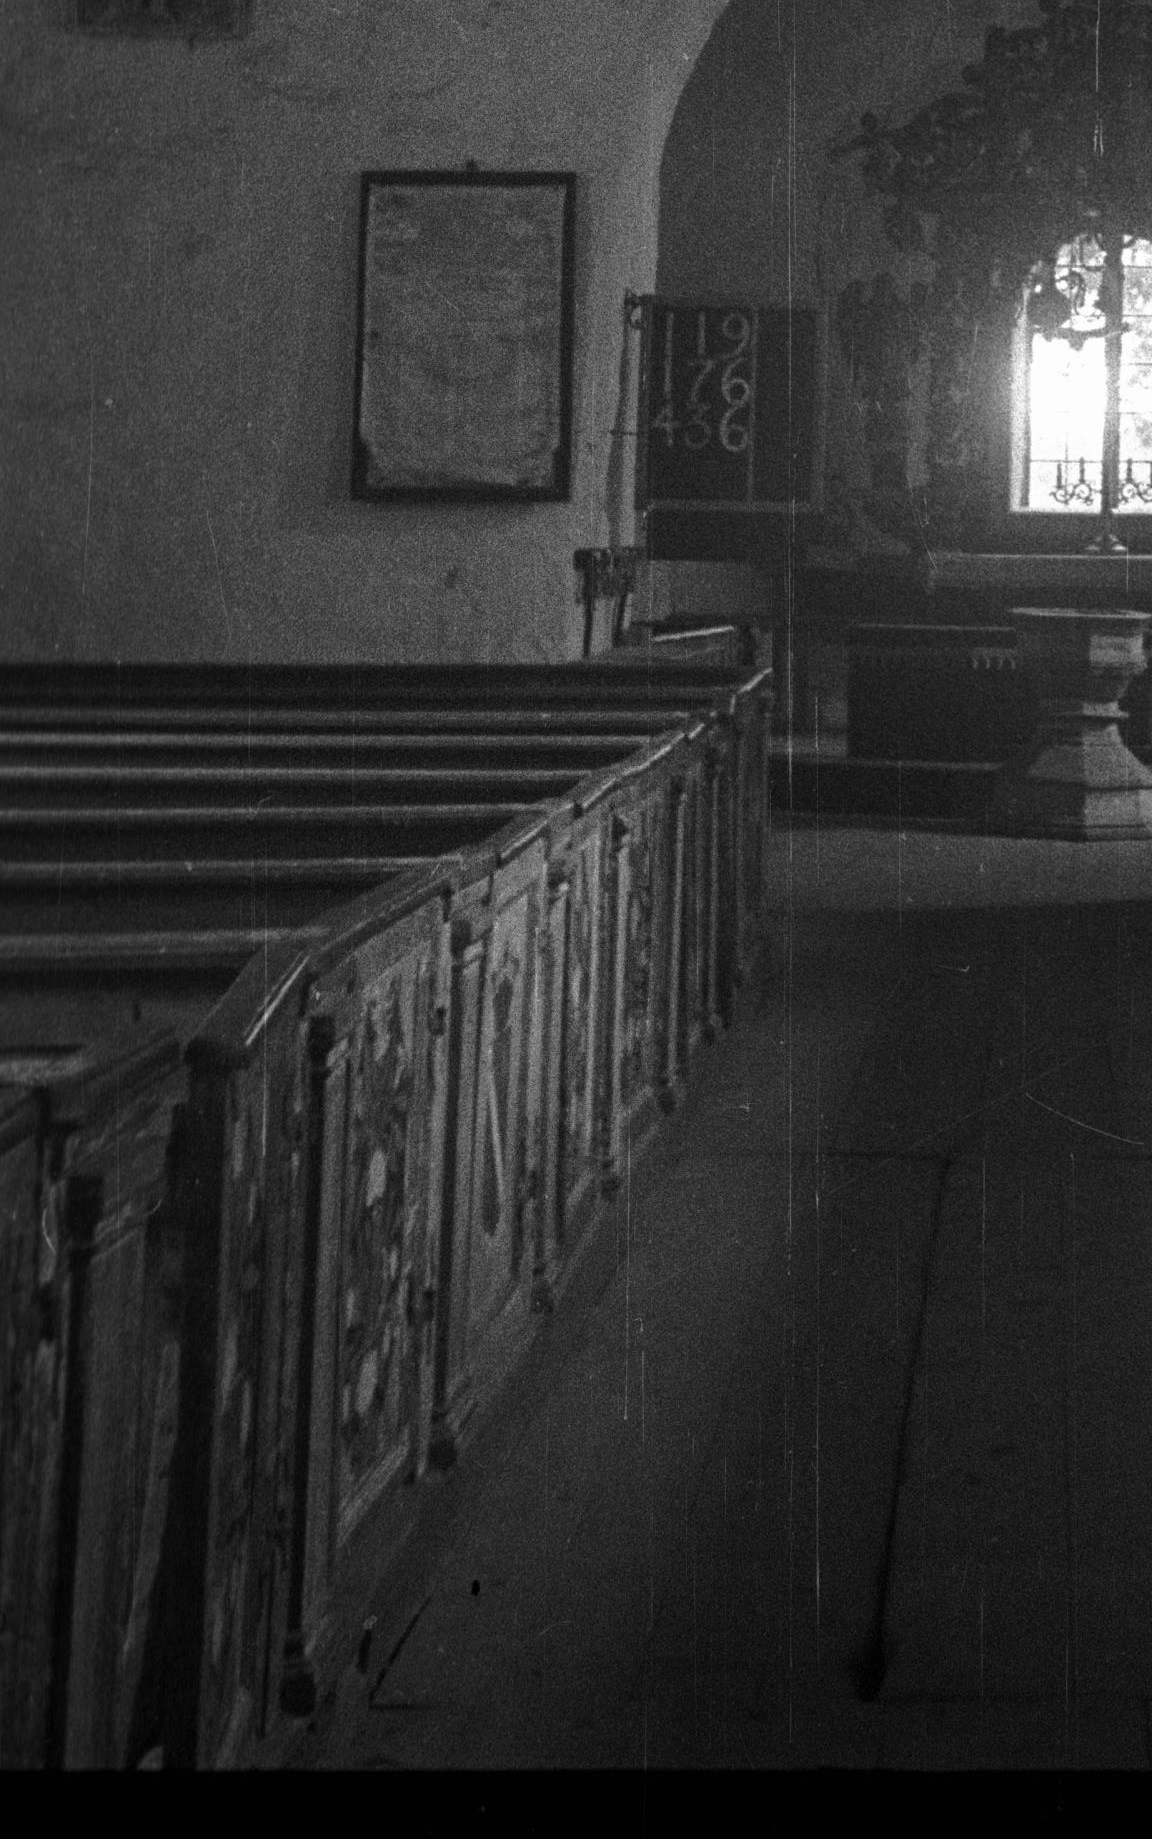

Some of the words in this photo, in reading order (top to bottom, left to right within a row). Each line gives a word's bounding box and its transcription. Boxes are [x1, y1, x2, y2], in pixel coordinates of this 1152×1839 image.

[667, 312, 751, 358] 119
[664, 356, 751, 406] 176
[651, 404, 750, 452] 486
